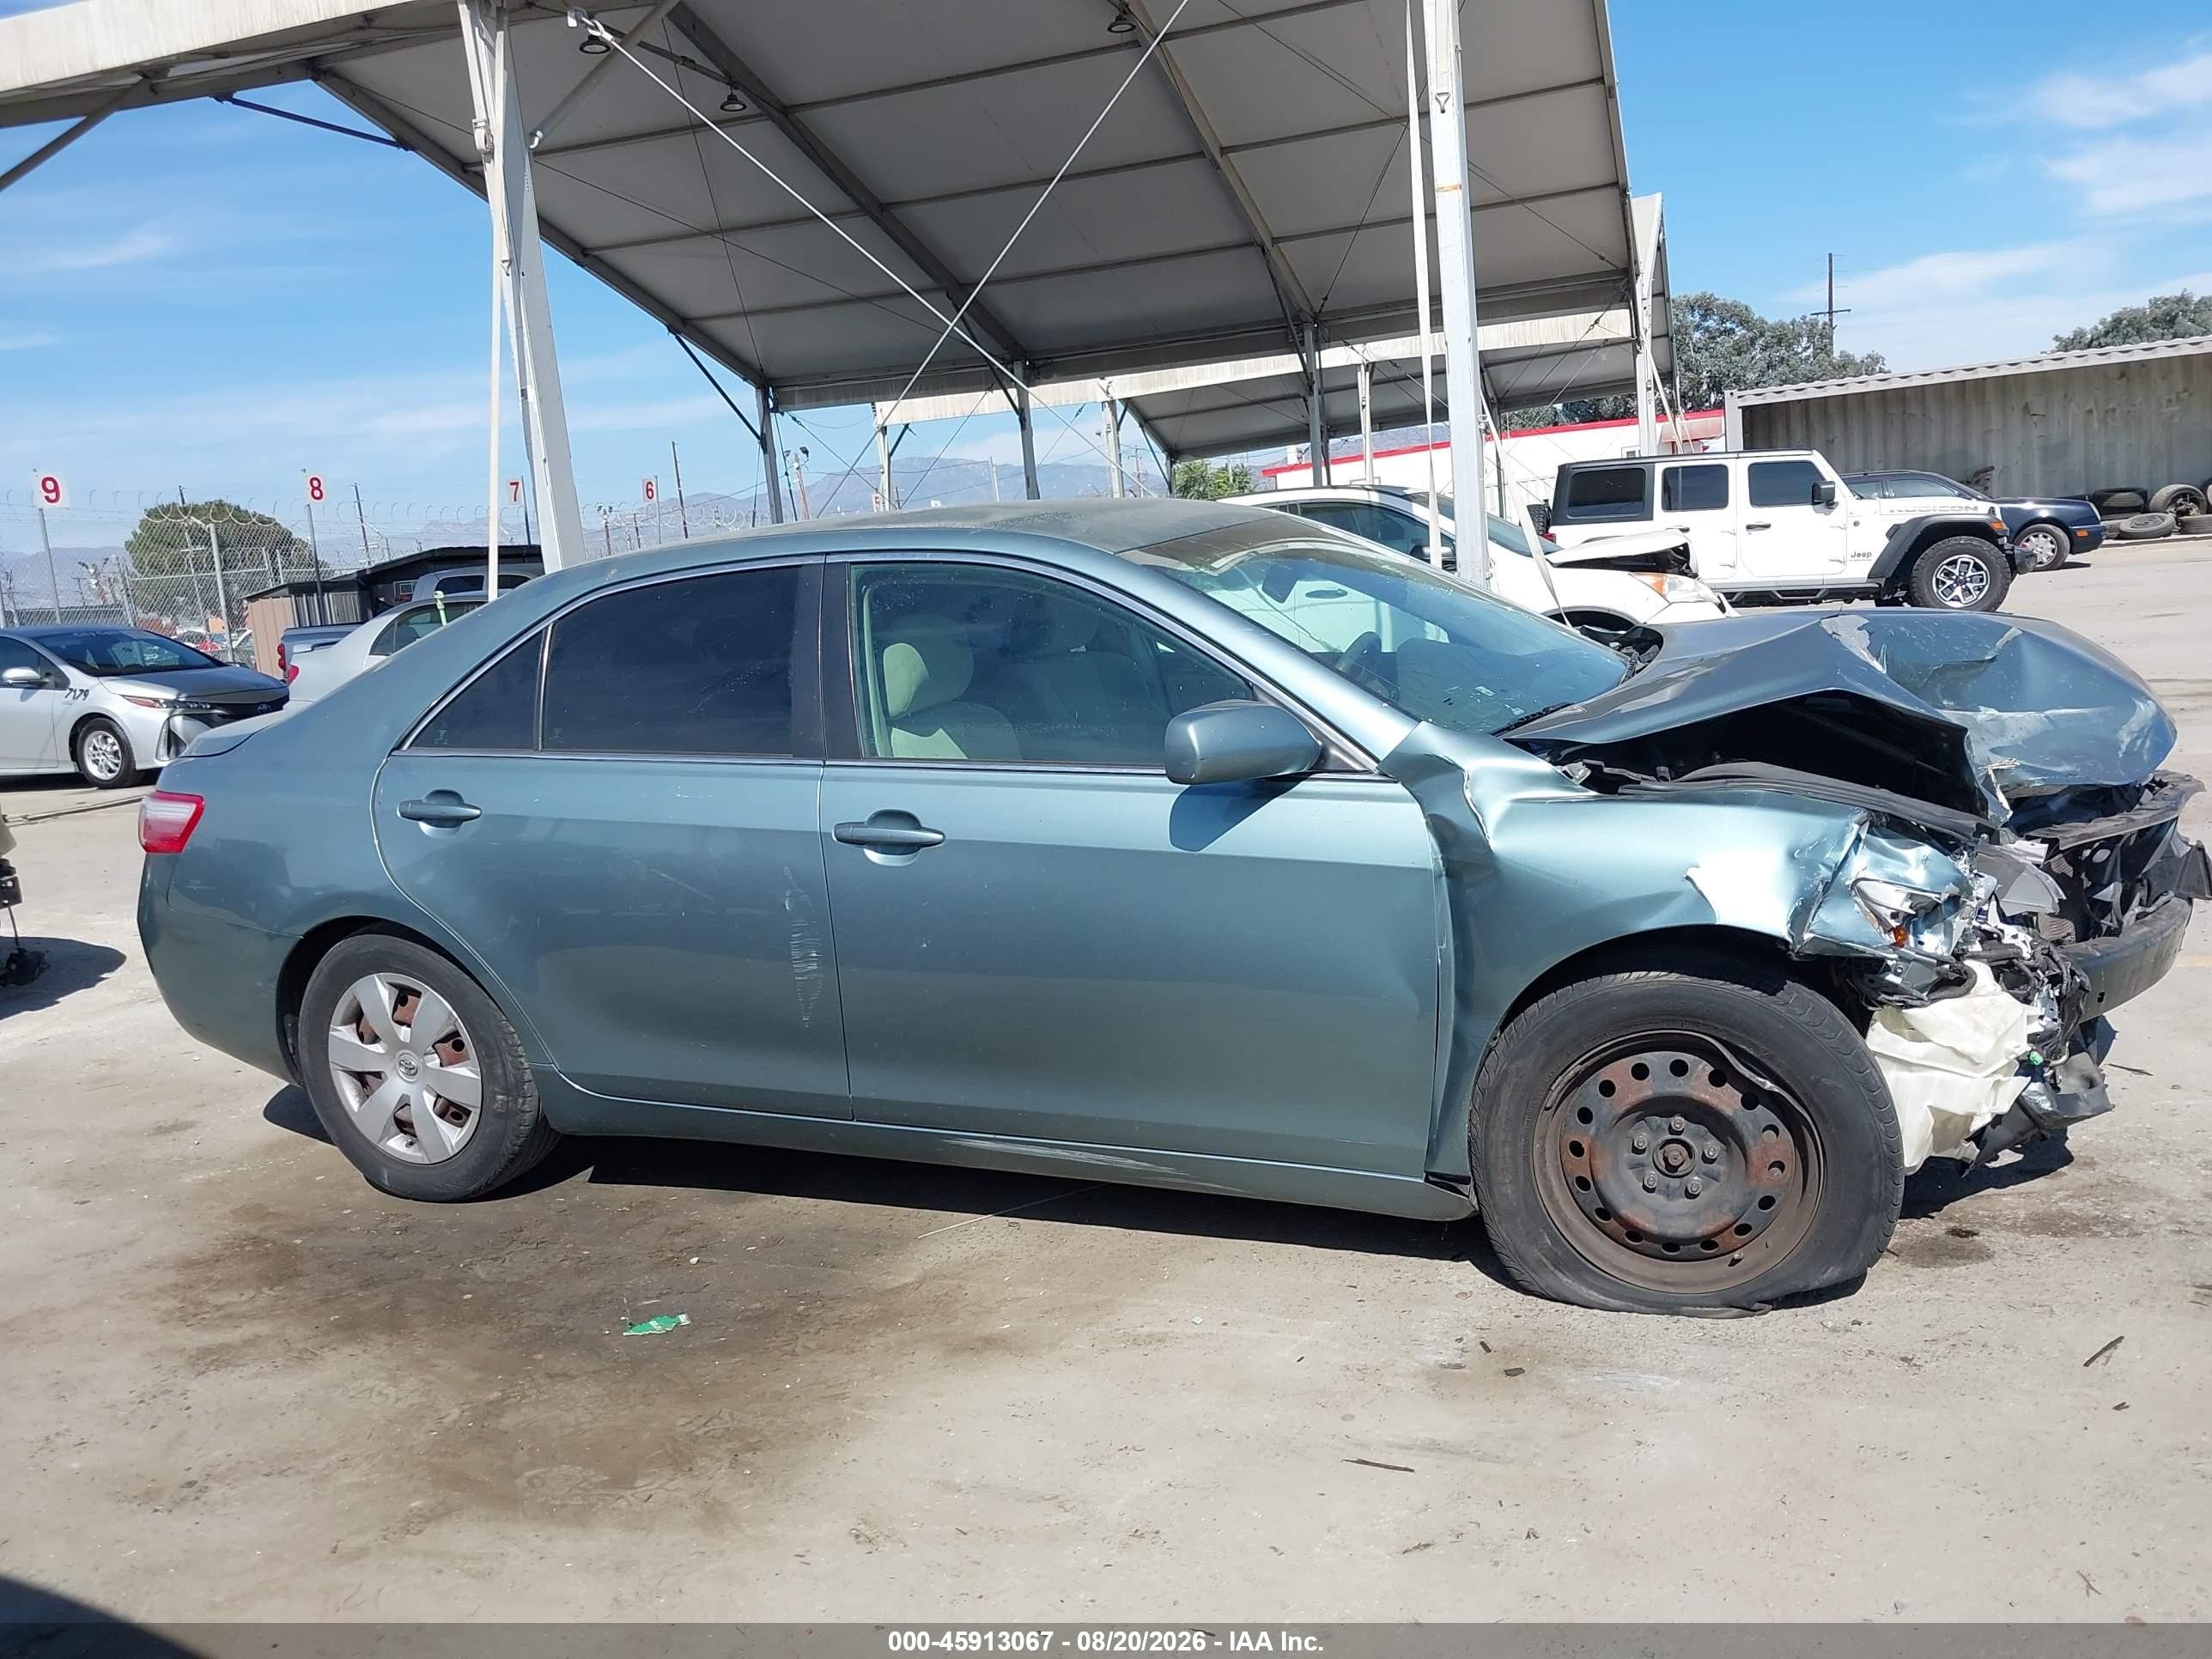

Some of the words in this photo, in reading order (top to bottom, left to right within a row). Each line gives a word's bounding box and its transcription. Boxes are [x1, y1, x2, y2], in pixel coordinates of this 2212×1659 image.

[41, 477, 60, 503] 9
[309, 477, 324, 501] 8
[509, 481, 520, 502] 7
[646, 481, 654, 500] 6
